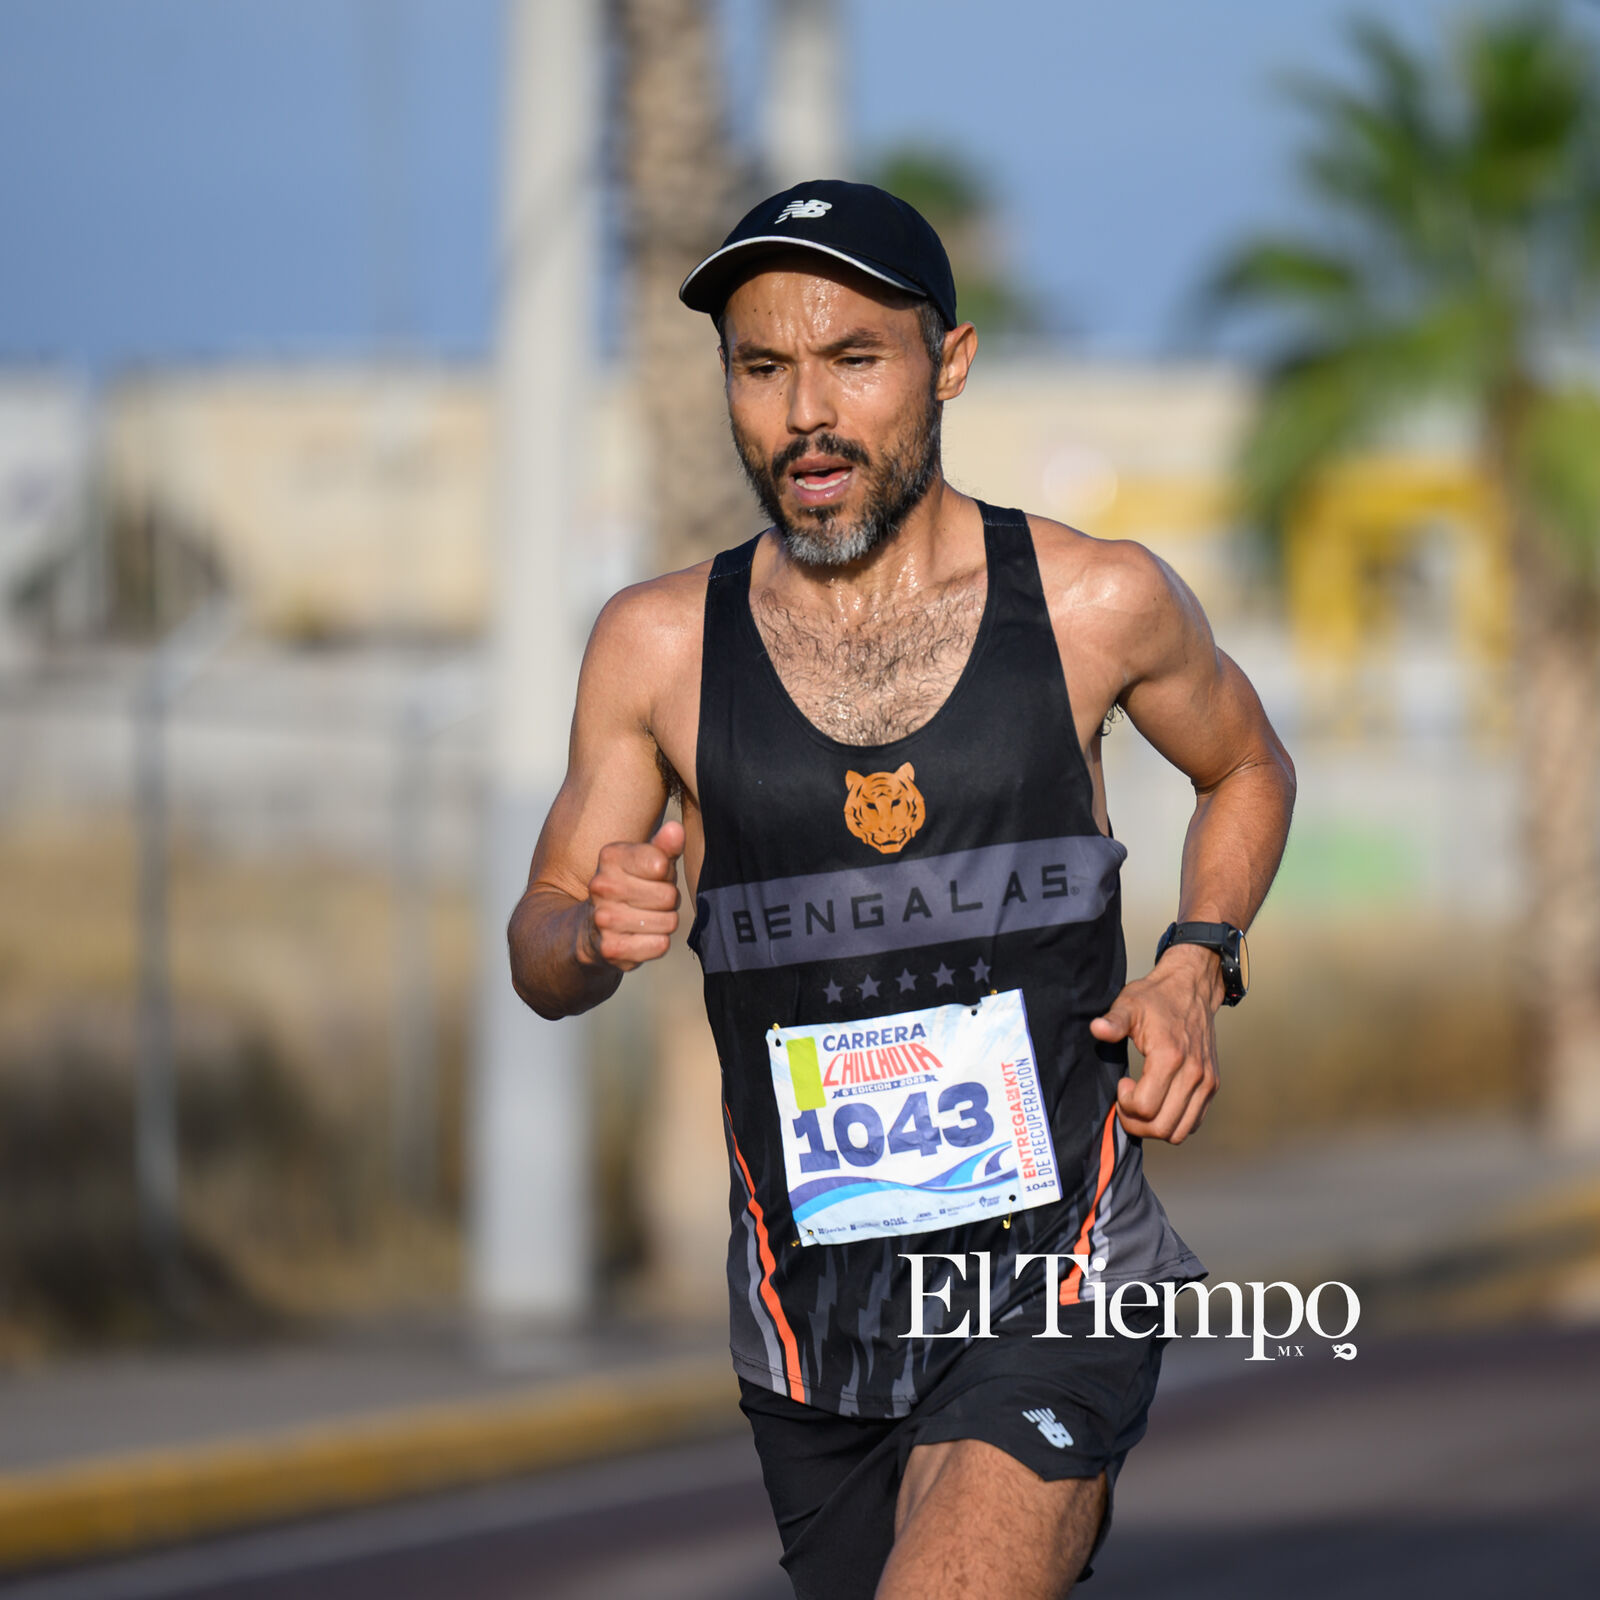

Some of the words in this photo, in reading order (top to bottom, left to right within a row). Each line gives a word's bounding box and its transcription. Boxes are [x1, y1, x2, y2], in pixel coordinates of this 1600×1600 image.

[732, 863, 1069, 944] BENGALAS
[822, 1022, 927, 1052] CARRERA
[822, 1042, 944, 1087] CHILCHOTA
[1001, 1062, 1018, 1088] KIT
[791, 1081, 995, 1174] 1043
[1015, 1057, 1050, 1157] RECUPERACIÓN
[1010, 1102, 1036, 1179] ENTREGA
[1025, 1179, 1056, 1192] 1043
[1035, 1158, 1054, 1177] DE
